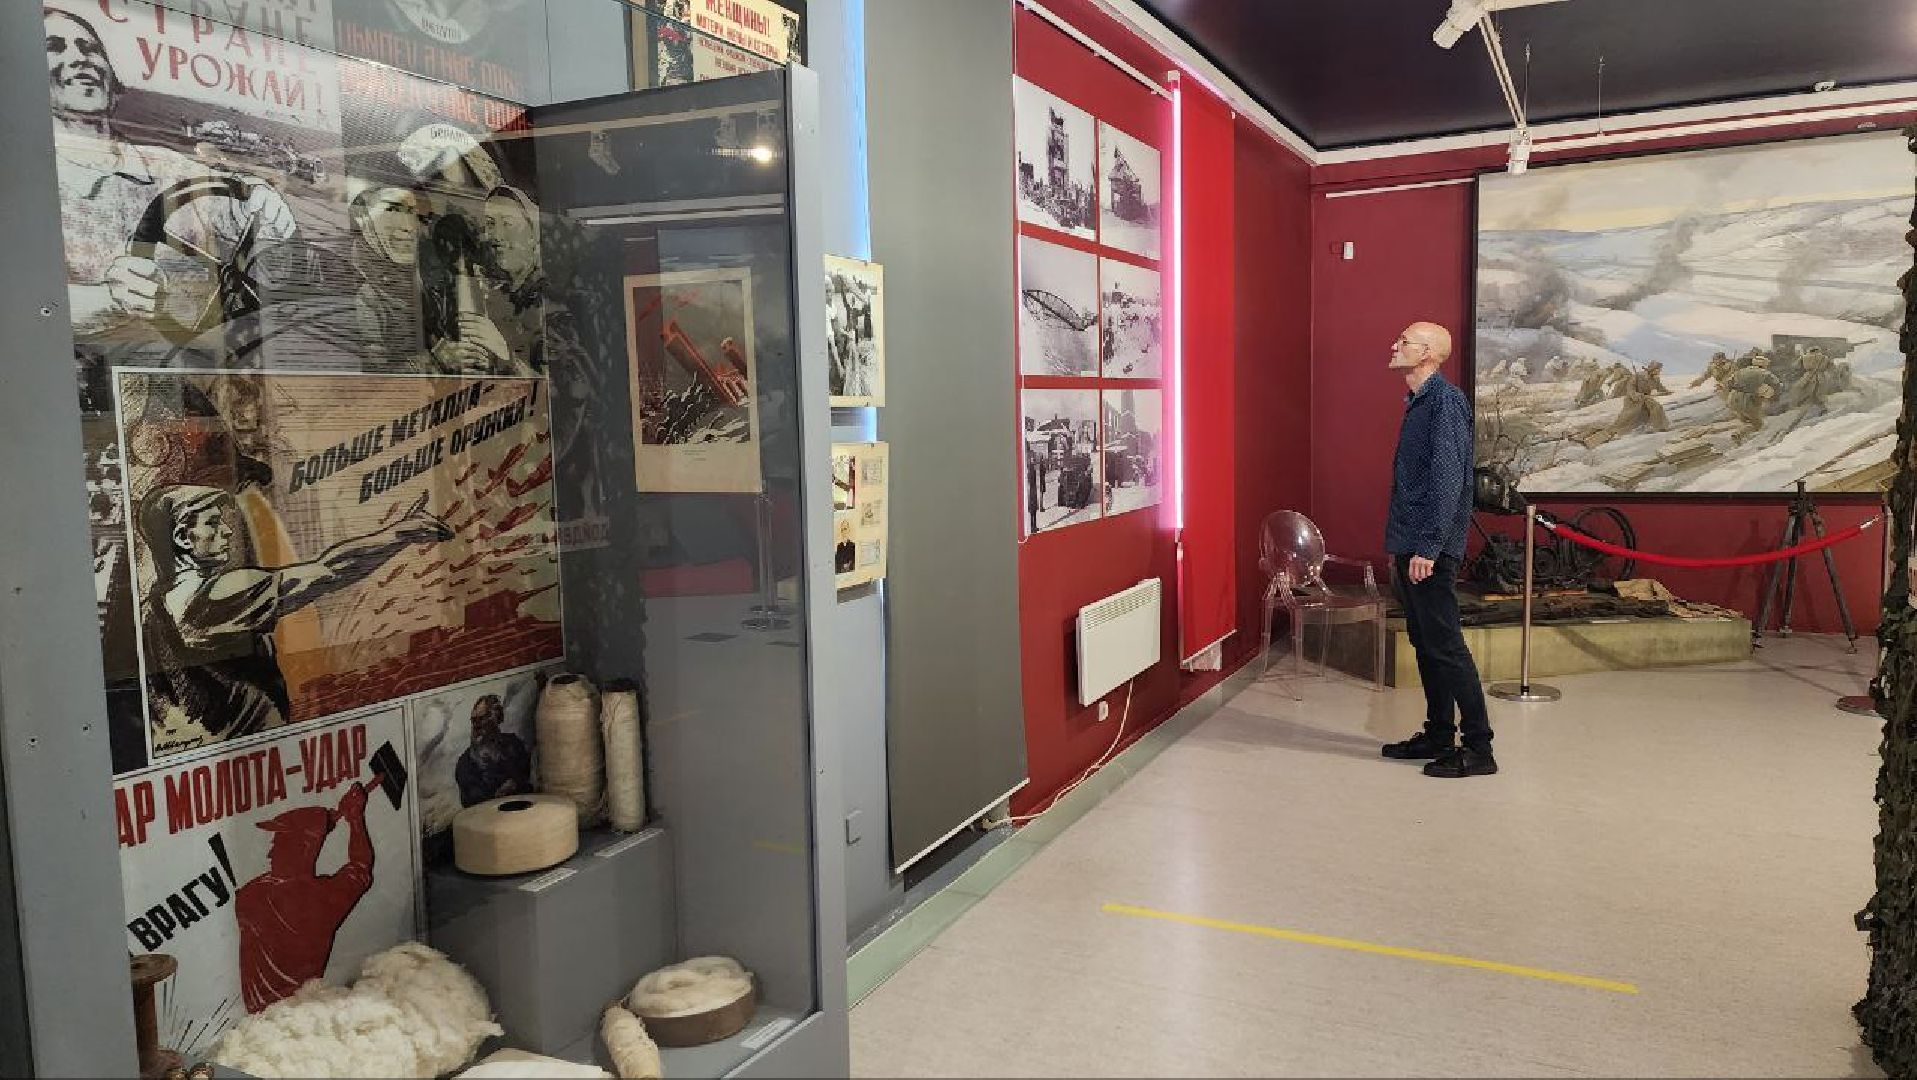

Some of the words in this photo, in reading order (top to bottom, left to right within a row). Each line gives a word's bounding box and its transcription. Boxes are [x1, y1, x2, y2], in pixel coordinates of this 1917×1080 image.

[288, 424, 386, 495] БОЛЬШЕ
[358, 436, 445, 504] БОЛЬШЕ
[114, 780, 155, 848] АР
[127, 831, 237, 953] ВРАГУ!
